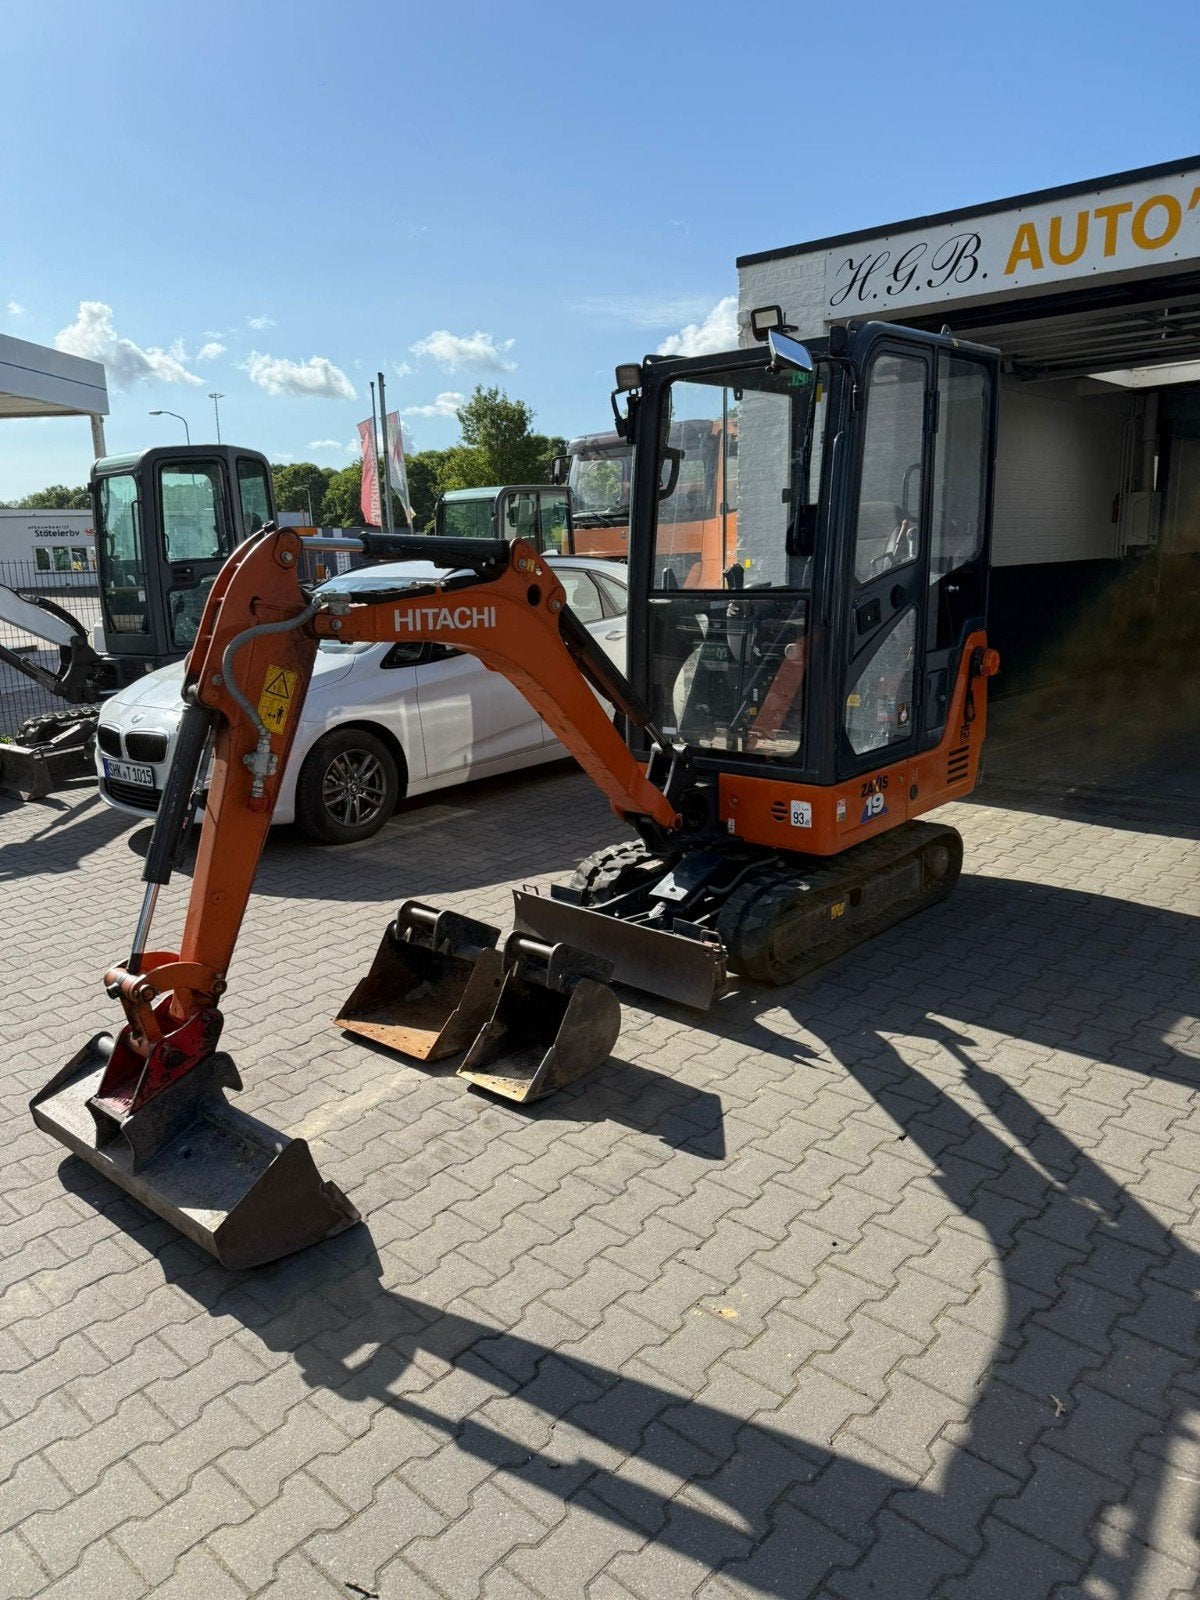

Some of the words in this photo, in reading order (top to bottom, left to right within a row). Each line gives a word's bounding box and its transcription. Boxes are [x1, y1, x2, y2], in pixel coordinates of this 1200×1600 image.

[829, 231, 988, 306] H.G.B.
[394, 606, 496, 632] HITACHI
[133, 767, 152, 784] 1015
[861, 774, 888, 798] ZAXIS
[866, 792, 884, 816] 19
[793, 811, 804, 825] 93
